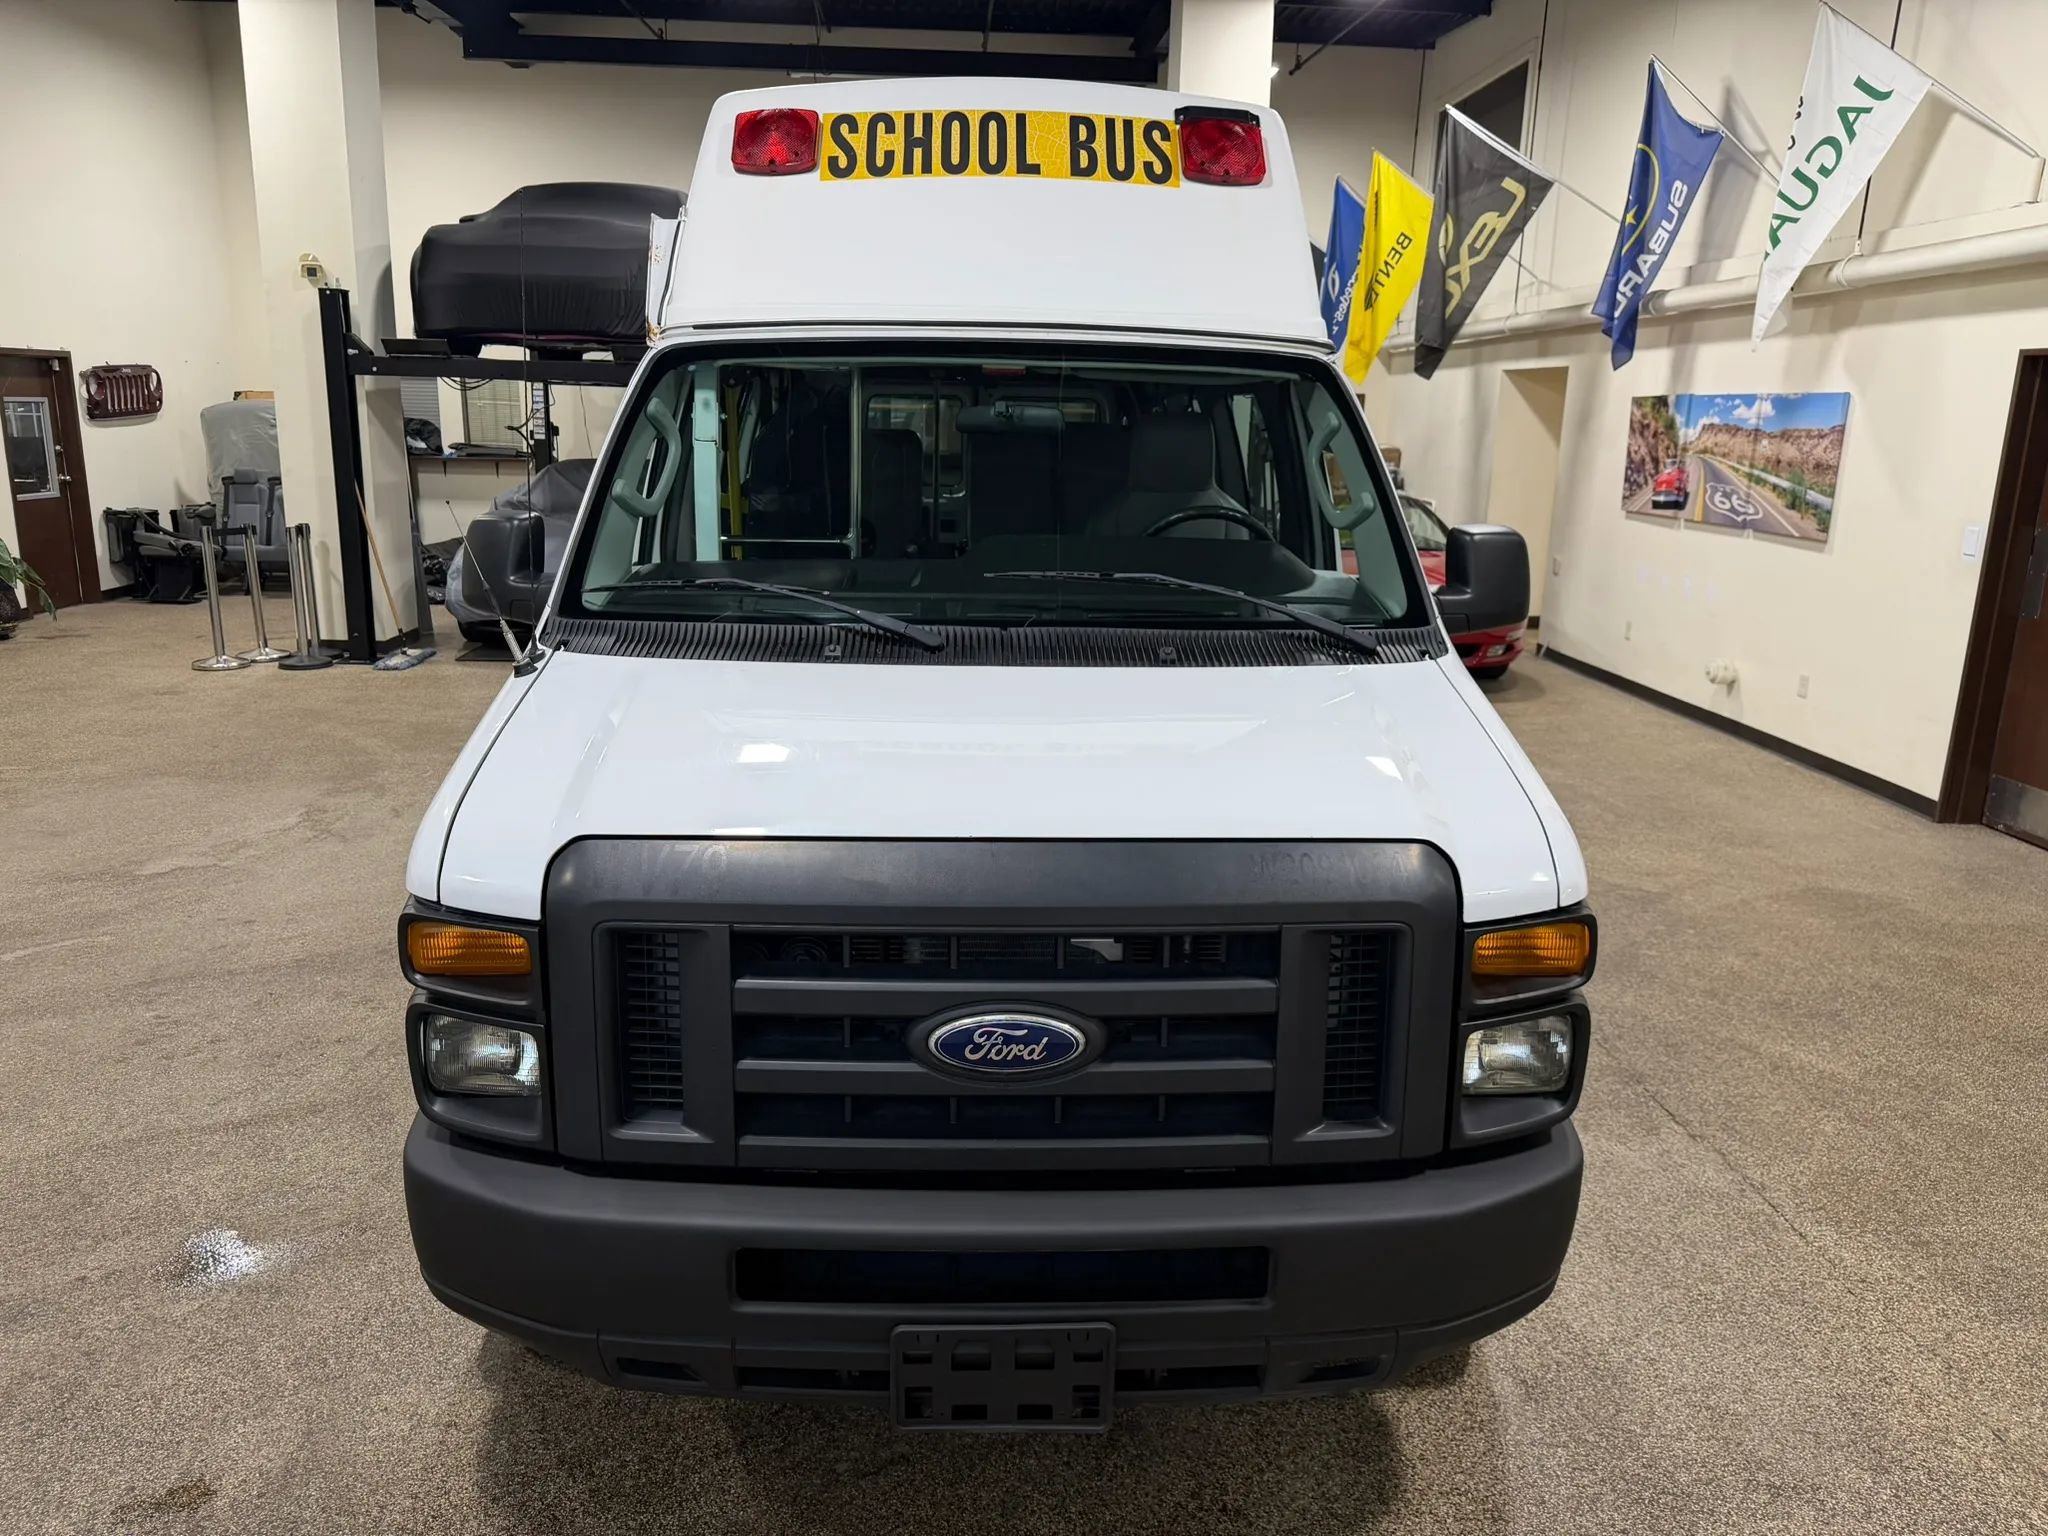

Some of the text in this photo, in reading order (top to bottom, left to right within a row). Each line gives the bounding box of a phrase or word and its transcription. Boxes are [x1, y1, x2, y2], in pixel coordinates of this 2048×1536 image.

[827, 110, 1173, 184] SCHOOL BUS
[1714, 491, 1755, 514] 66
[965, 1027, 1049, 1060] Ford
